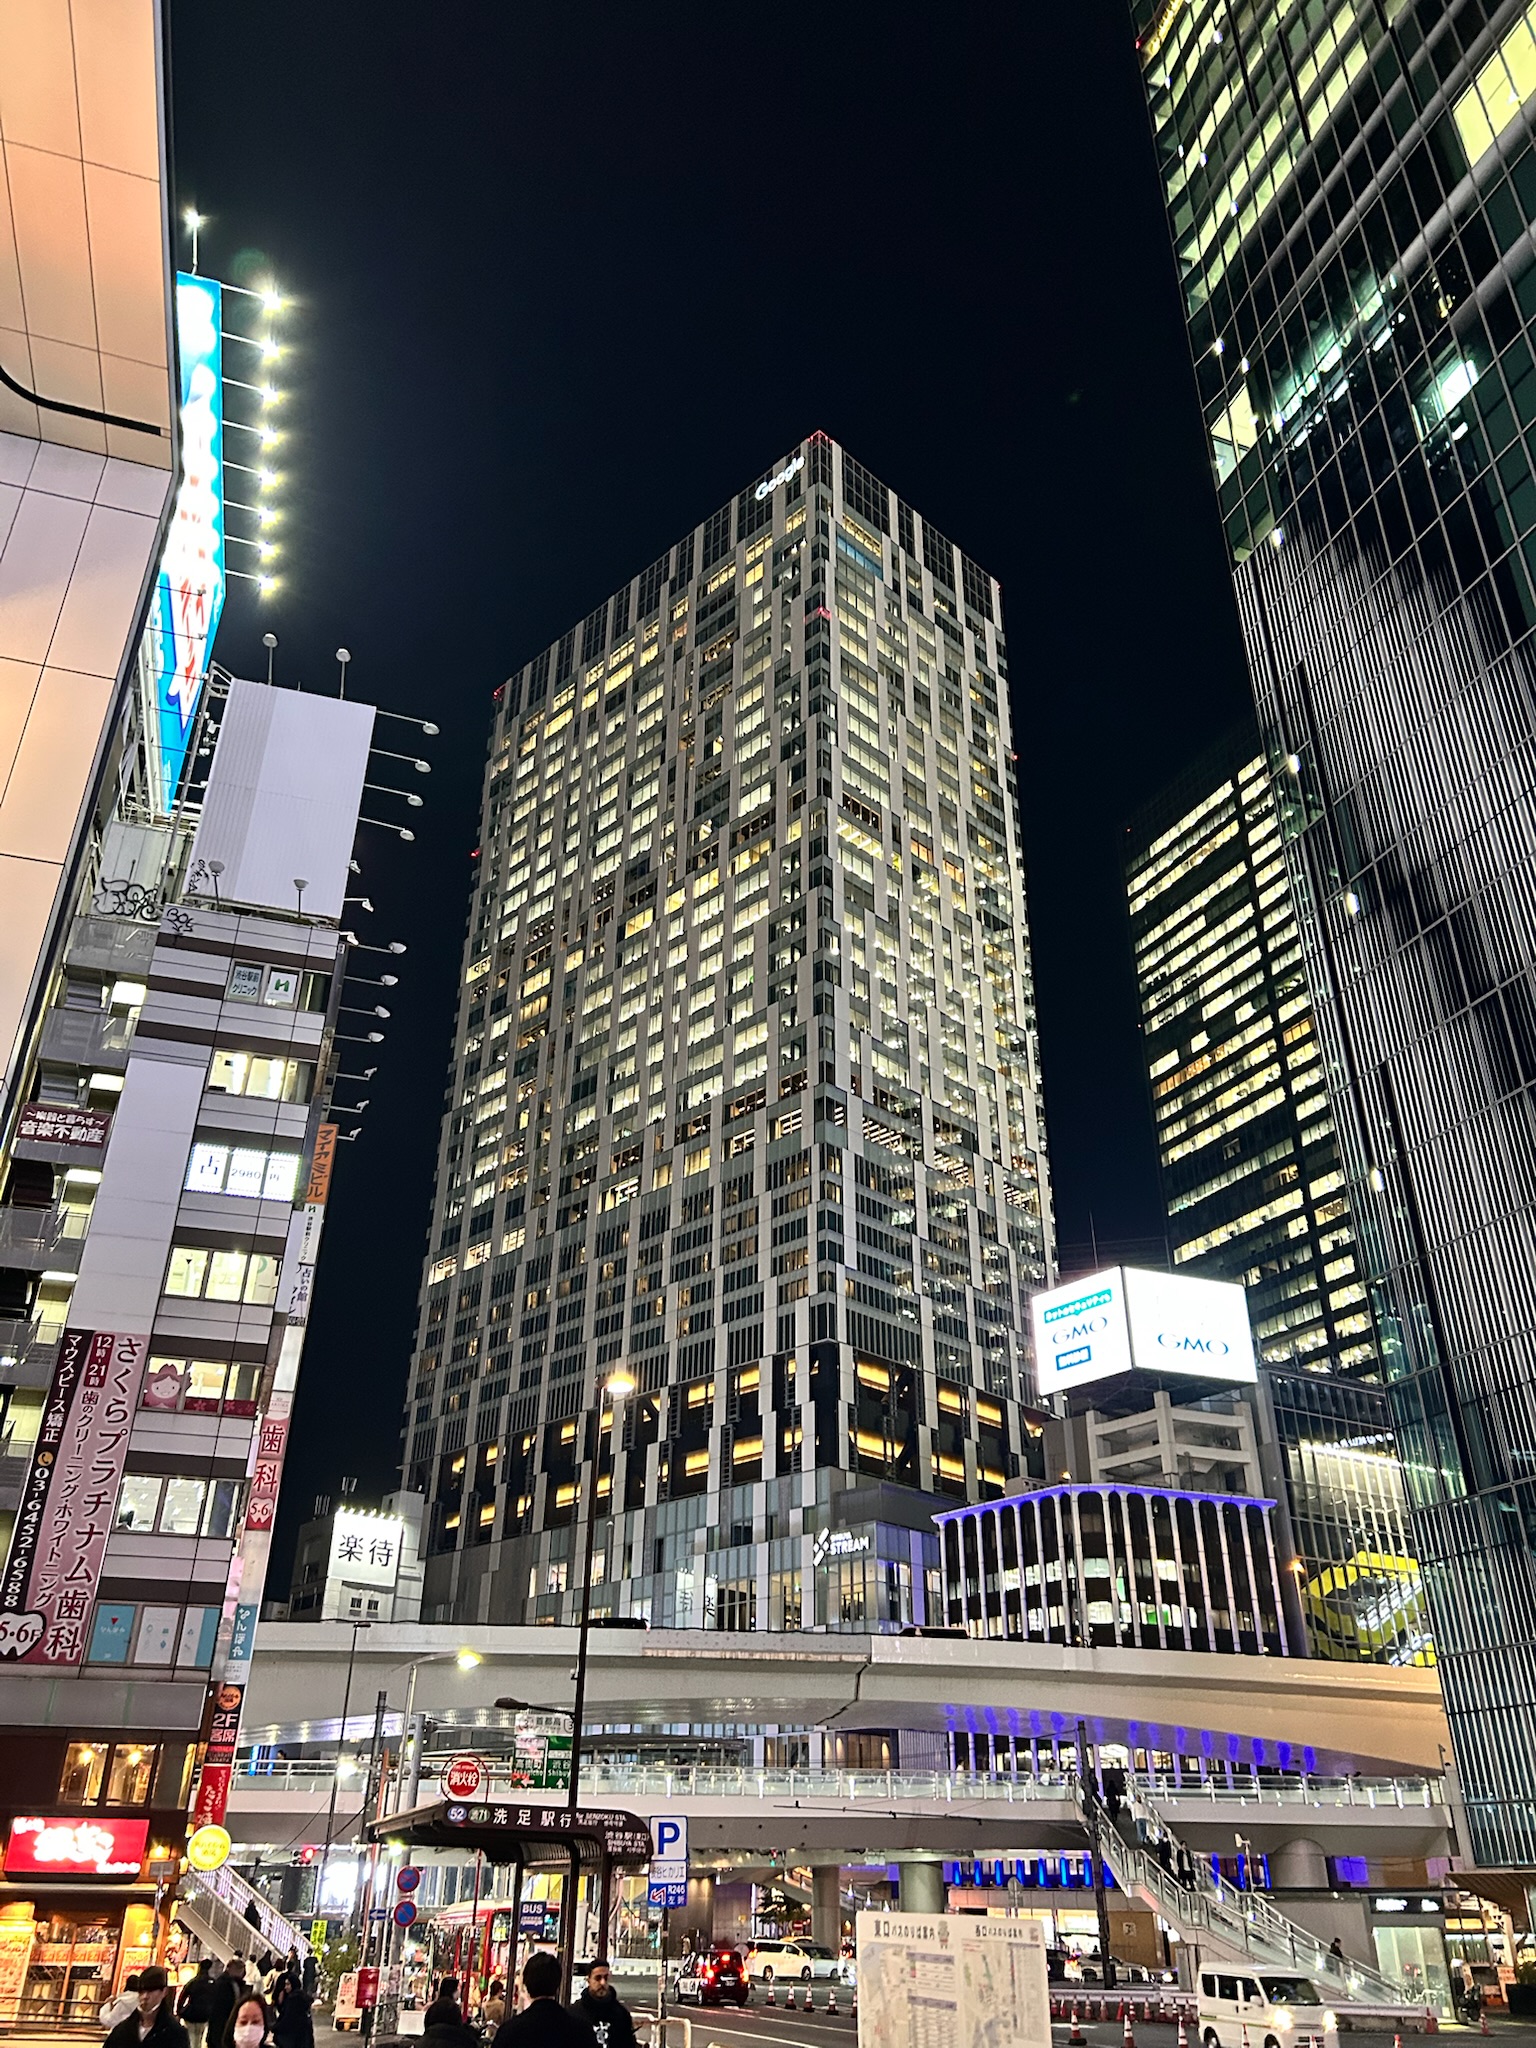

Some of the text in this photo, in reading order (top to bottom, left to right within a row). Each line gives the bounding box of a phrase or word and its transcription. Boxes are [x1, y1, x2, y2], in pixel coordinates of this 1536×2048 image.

[755, 456, 805, 500] Google
[232, 984, 257, 996] クリニック
[20, 1120, 105, 1143] 音楽不動産
[1052, 1316, 1108, 1345] GMO
[1157, 1332, 1229, 1356] GMO
[42, 1334, 83, 1443] マウスピース矯正
[253, 1425, 285, 1493] 歯科
[46, 1338, 142, 1659] さくらプラチナム歯科
[4, 1467, 50, 1608] 03-6452-6588
[830, 1535, 869, 1556] STREAM
[338, 1534, 394, 1567] 楽待
[232, 1607, 251, 1658] なんぼや
[212, 1713, 239, 1728] 2F
[209, 1729, 237, 1743] 客席
[449, 1771, 479, 1787] 消火栓
[450, 1808, 465, 1820] 52
[493, 1808, 572, 1829] 洗足駅行
[657, 1822, 681, 1855] P
[667, 1884, 686, 1895] R246
[522, 1903, 544, 1914] BUS
